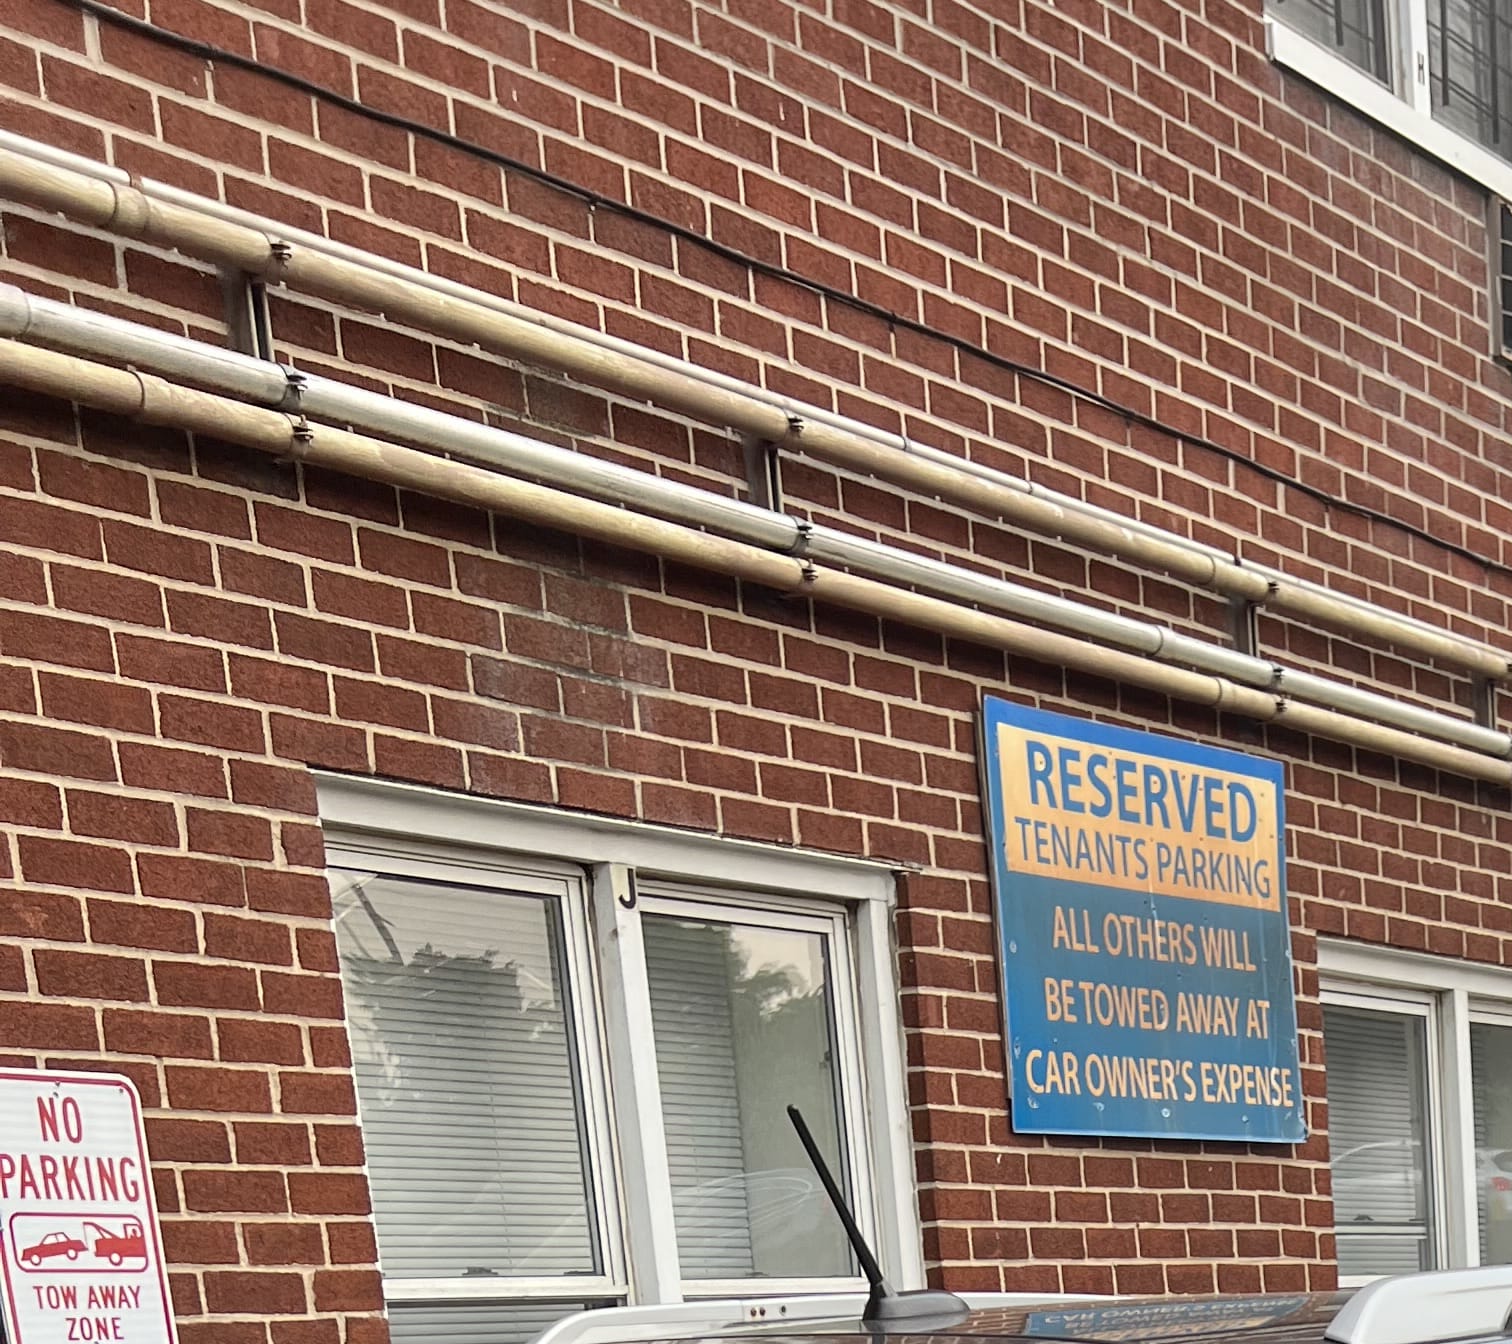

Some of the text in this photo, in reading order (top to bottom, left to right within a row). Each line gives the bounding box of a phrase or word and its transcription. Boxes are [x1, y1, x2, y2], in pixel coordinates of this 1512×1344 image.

[1025, 740, 1257, 844] RESERVED
[1015, 816, 1271, 899] TENANTS PARKING
[618, 867, 636, 909] J
[1052, 906, 1257, 972] ALL OTHERS WILL
[1044, 977, 1270, 1040] BE TOWED AWAY AT
[1025, 1049, 1293, 1108] CAR OWNER'S EXPENSE
[37, 1096, 83, 1144] NO
[0, 1153, 140, 1202] PARKING
[33, 1285, 141, 1310] TOW AWAY
[65, 1317, 124, 1341] ZONE
